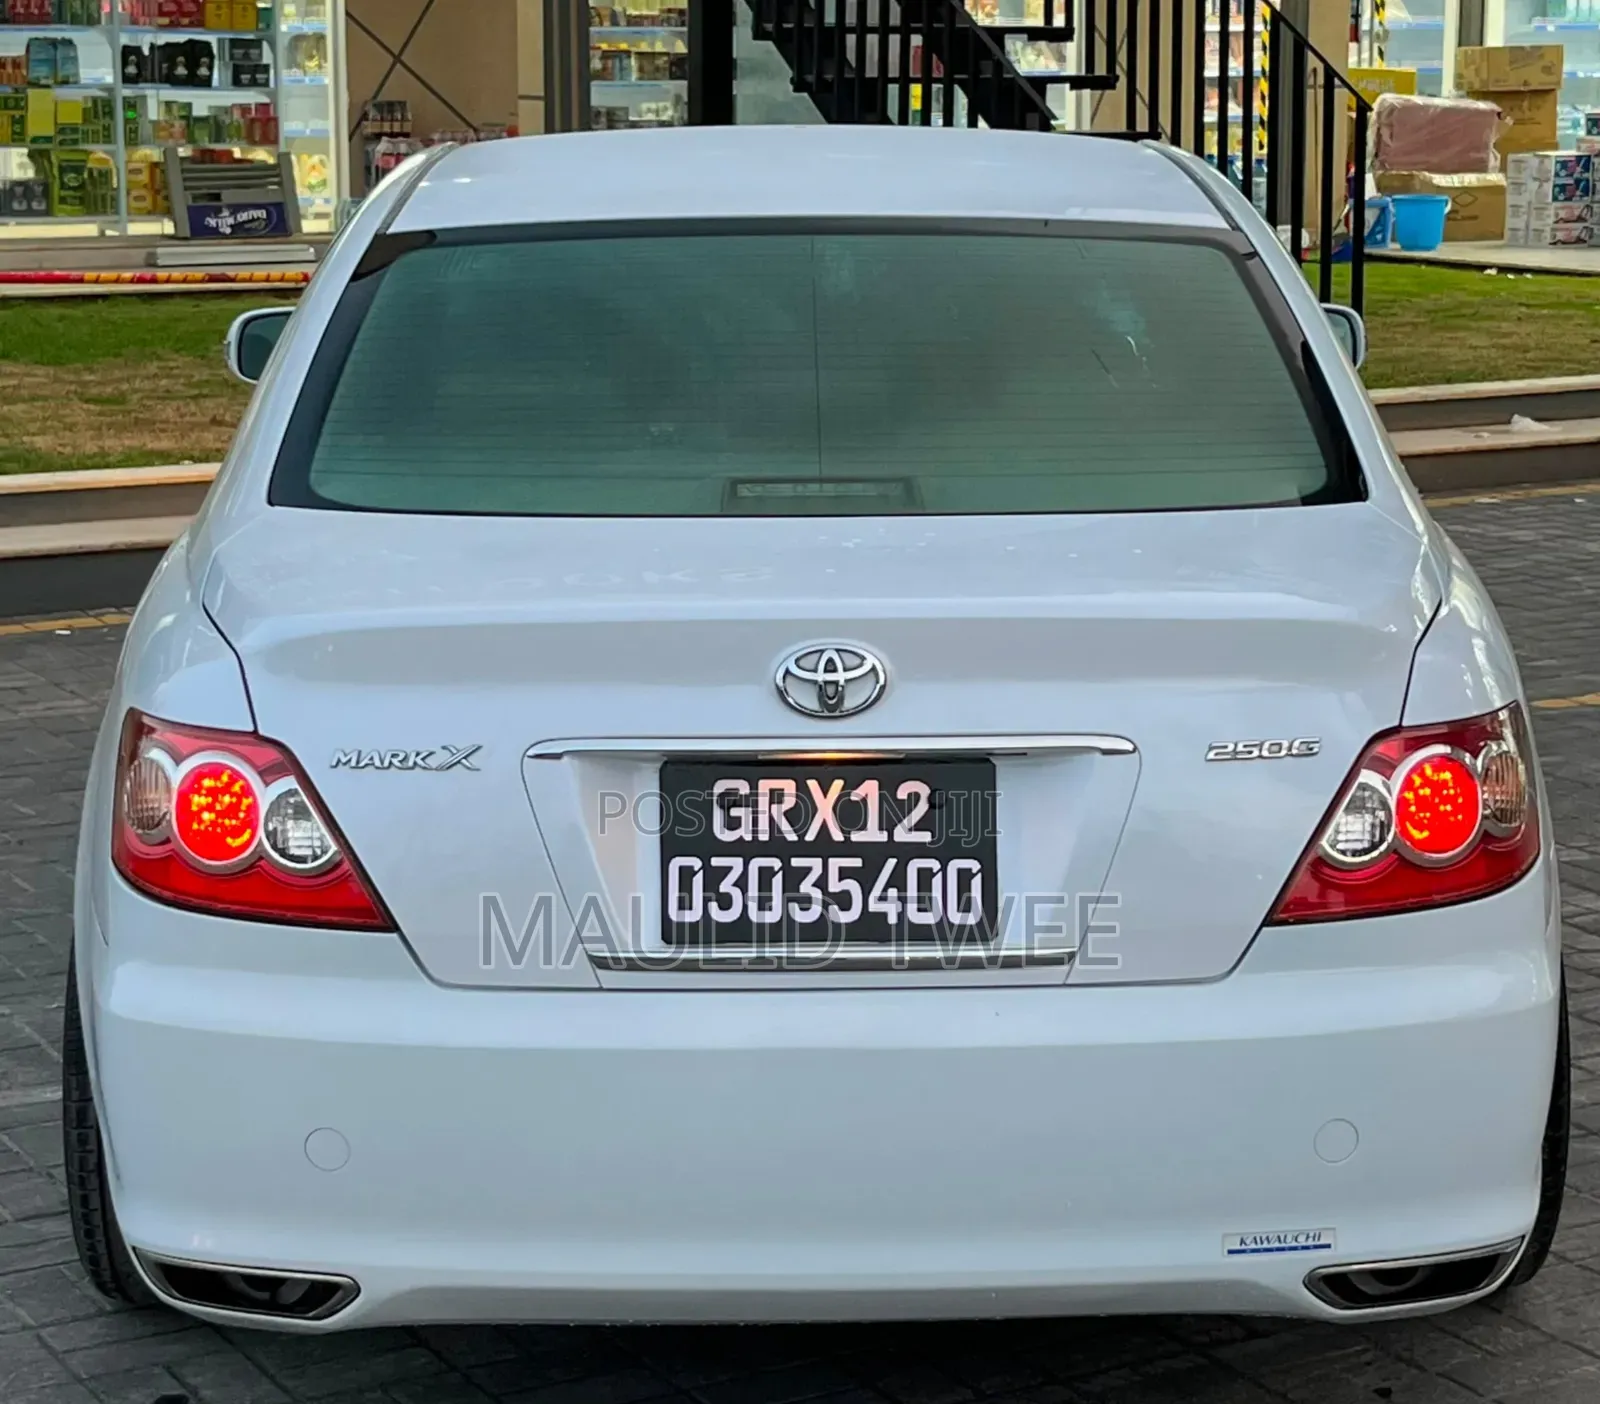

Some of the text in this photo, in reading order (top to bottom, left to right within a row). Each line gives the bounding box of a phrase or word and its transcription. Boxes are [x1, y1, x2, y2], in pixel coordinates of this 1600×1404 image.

[1204, 736, 1321, 762] 250G
[712, 778, 933, 843] GRX12
[667, 855, 983, 925] 03035400
[1239, 1231, 1323, 1247] KAWAUCHI
